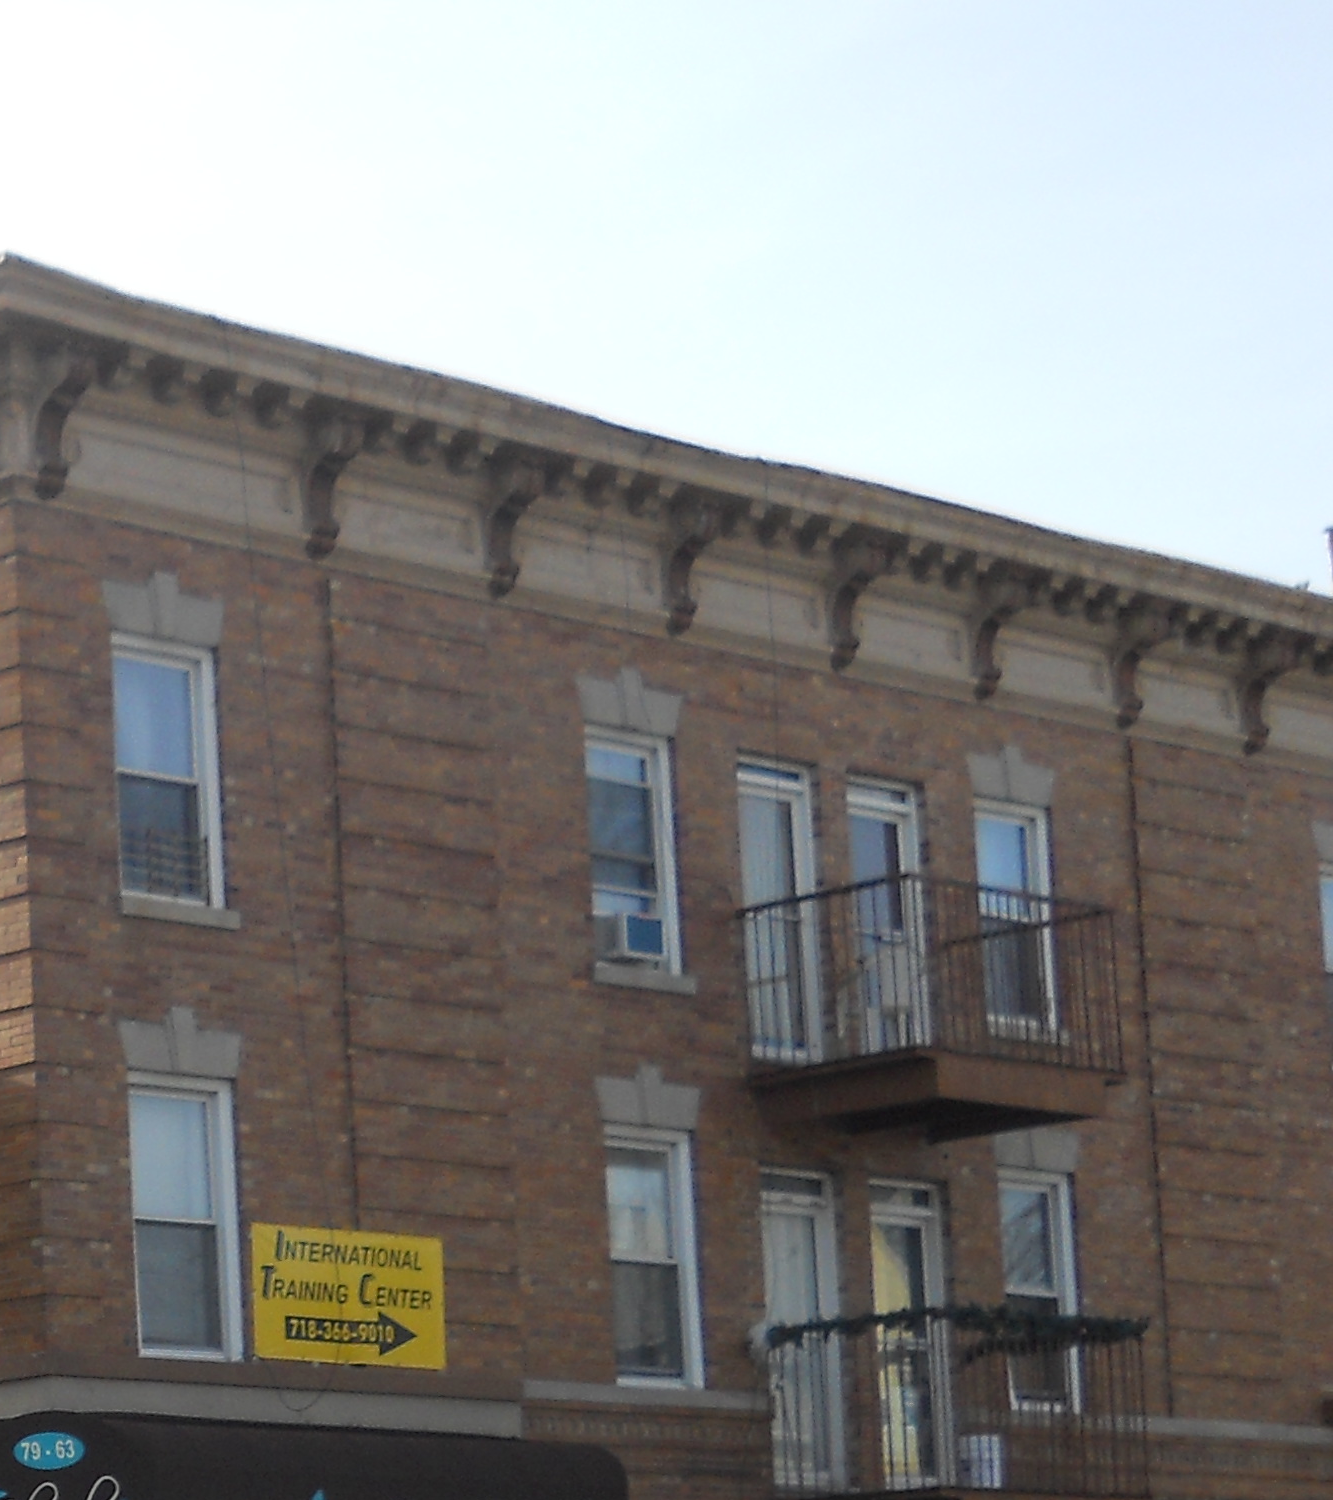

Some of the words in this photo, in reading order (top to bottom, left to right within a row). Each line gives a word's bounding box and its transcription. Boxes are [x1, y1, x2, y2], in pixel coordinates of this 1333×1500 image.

[275, 1230, 423, 1271] INTERNATIONAL
[260, 1265, 349, 1305] TRAINING
[359, 1273, 433, 1311] CENTER
[289, 1319, 395, 1344] 718-366-9010
[20, 1440, 41, 1461] 79
[55, 1439, 76, 1459] 63
